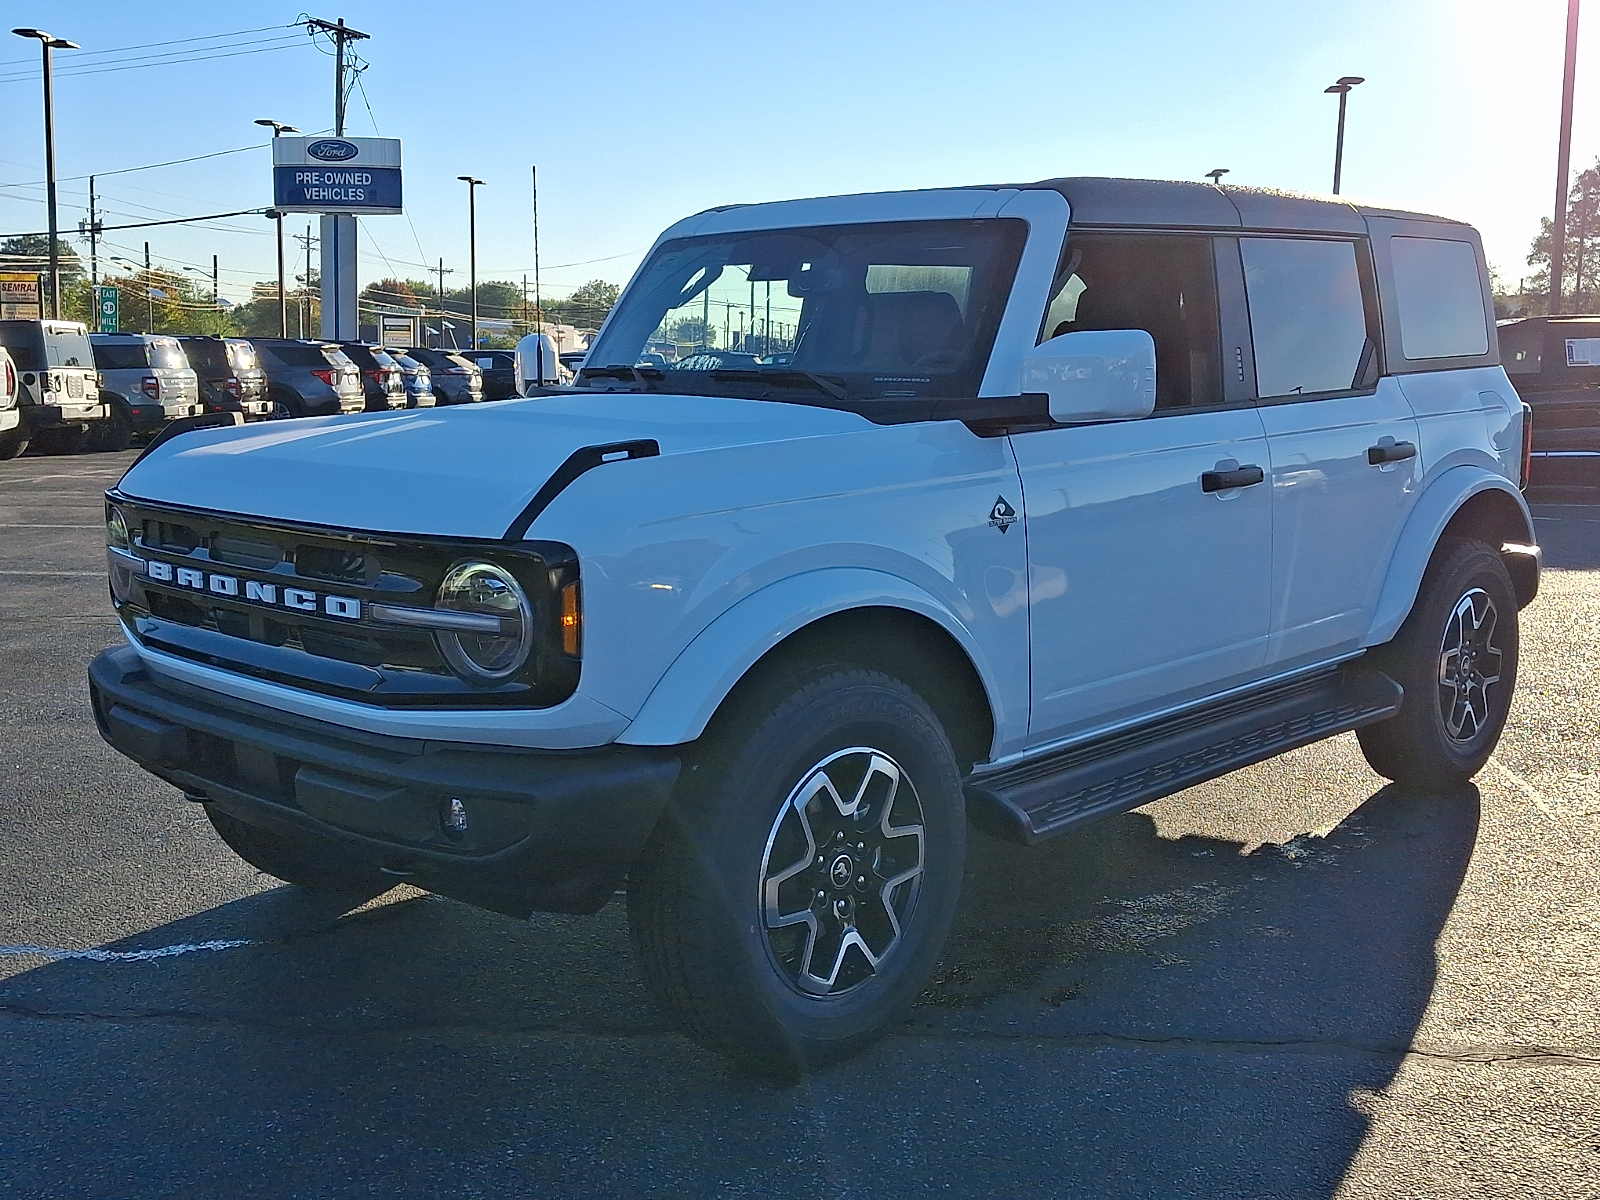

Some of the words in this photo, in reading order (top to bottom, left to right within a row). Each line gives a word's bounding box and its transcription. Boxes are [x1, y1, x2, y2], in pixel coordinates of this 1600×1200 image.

[318, 143, 347, 157] Ford
[295, 172, 372, 185] PRE-OWNED
[304, 187, 365, 201] VEHICLES
[1, 282, 38, 292] SEMRAJ
[102, 289, 116, 298] EAST
[101, 317, 117, 326] MILE
[148, 560, 361, 620] BRONCO
